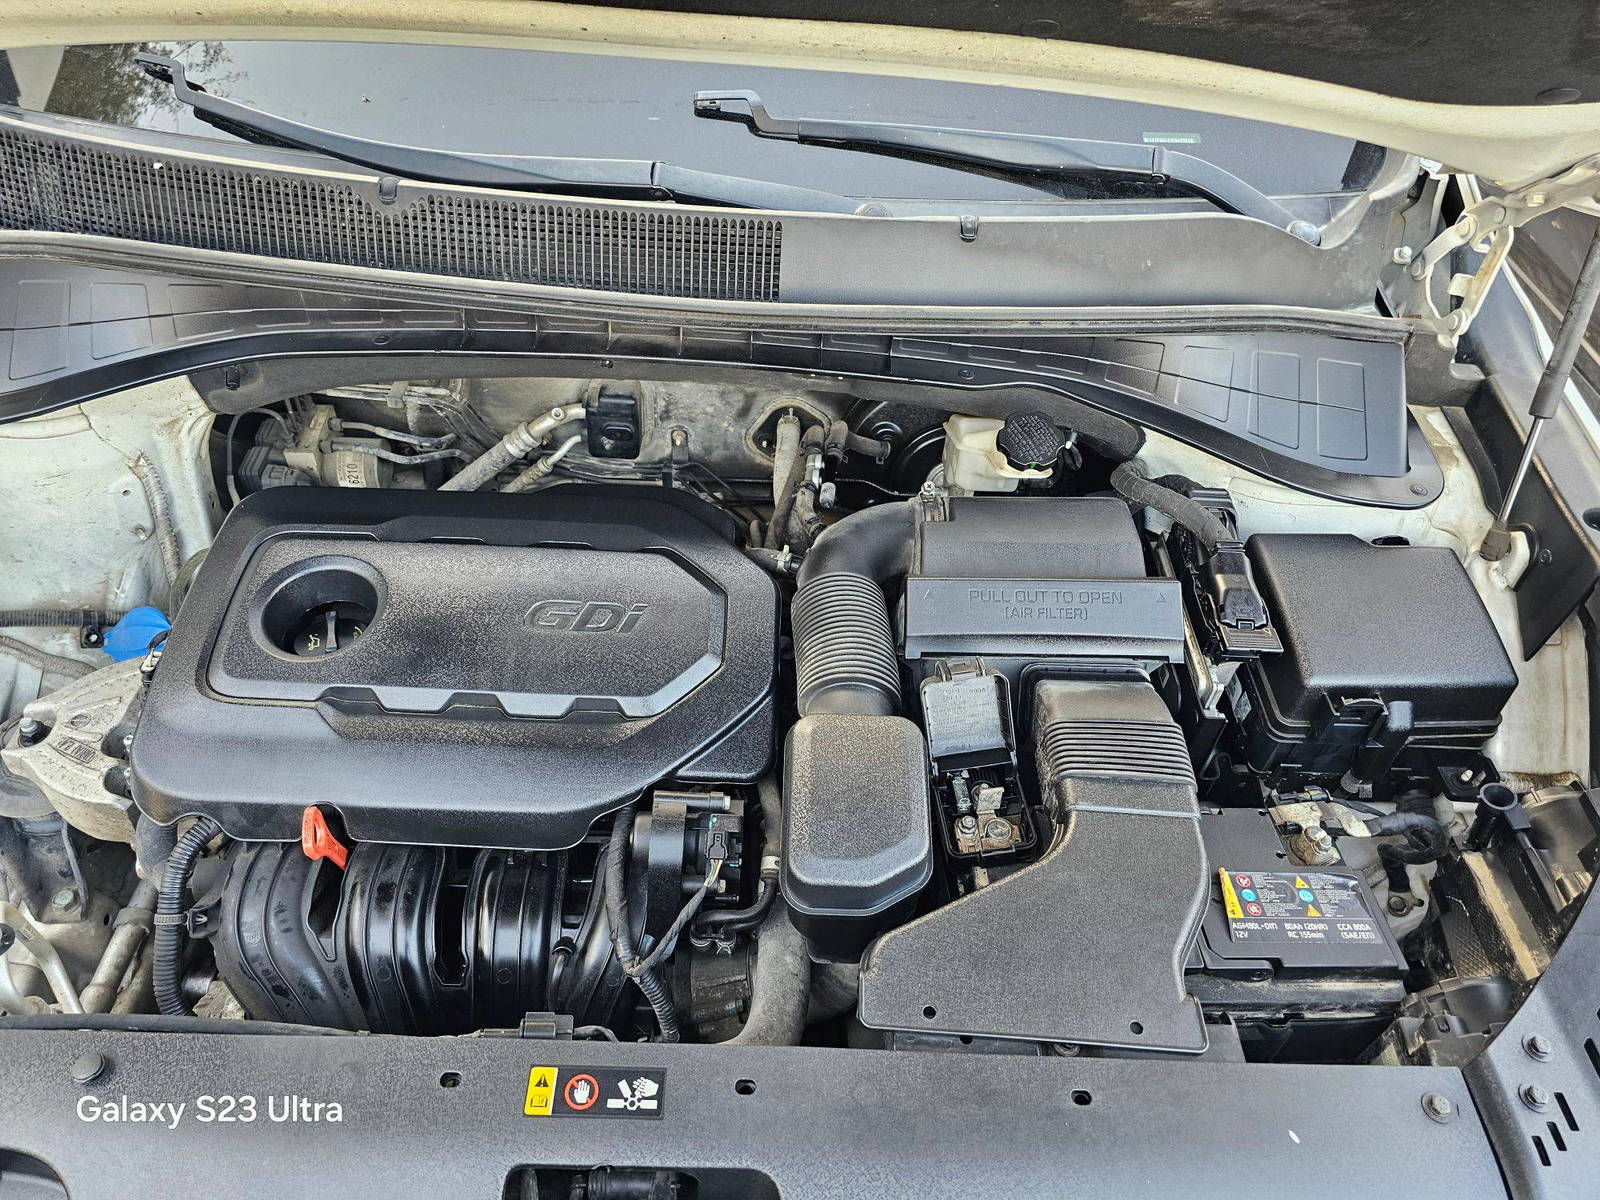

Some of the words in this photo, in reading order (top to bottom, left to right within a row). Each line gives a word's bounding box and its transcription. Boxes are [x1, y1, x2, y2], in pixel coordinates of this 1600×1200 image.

[347, 463, 360, 485] 6210
[969, 589, 1010, 604] PULL
[1014, 590, 1047, 604] OUT
[1052, 590, 1074, 604] TO
[1078, 590, 1123, 605] OPEN
[523, 599, 649, 634] GDi
[1004, 606, 1033, 620] (AIR
[1036, 606, 1089, 620] FILTER)
[1336, 923, 1353, 931] CCA
[1235, 931, 1249, 939] 12V
[1287, 931, 1299, 939] RC
